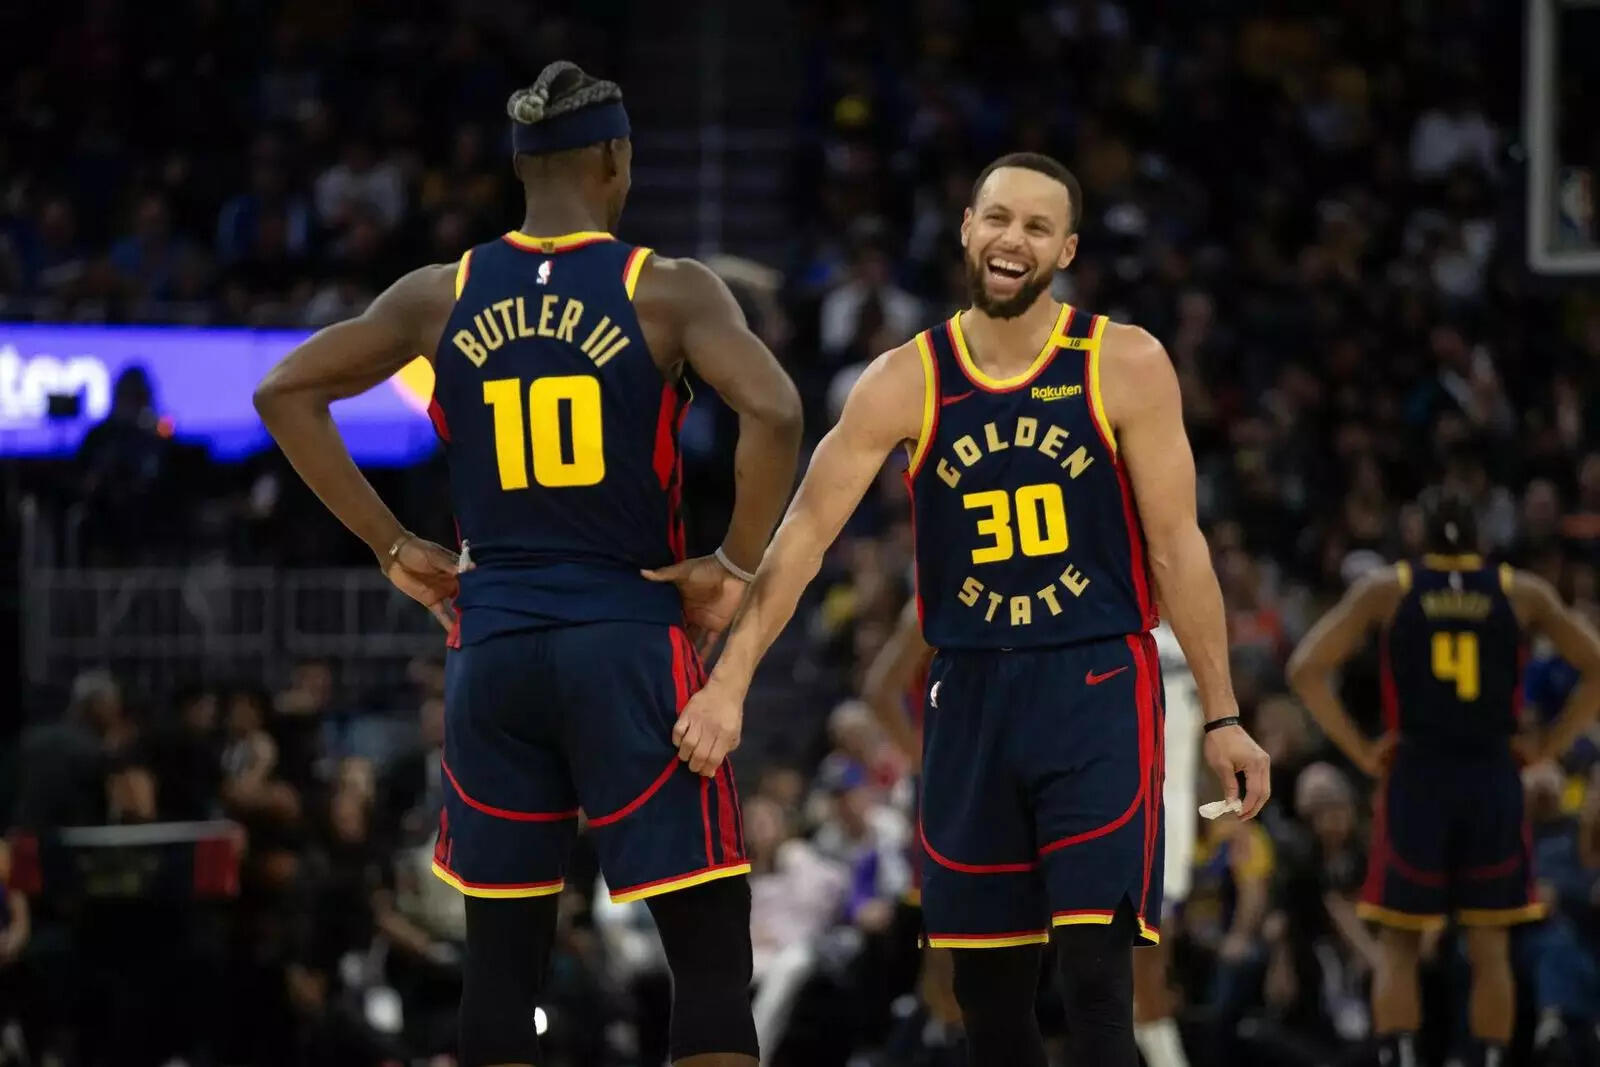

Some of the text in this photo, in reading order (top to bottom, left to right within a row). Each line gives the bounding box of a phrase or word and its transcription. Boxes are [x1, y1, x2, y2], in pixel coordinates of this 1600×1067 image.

[452, 294, 631, 368] BUTLER III
[1031, 384, 1083, 401] Rakuten
[482, 374, 606, 491] 10
[936, 416, 1095, 489] GOLDEN
[962, 482, 1069, 565] 30
[957, 563, 1091, 626] STATE
[1431, 630, 1480, 702] 4
